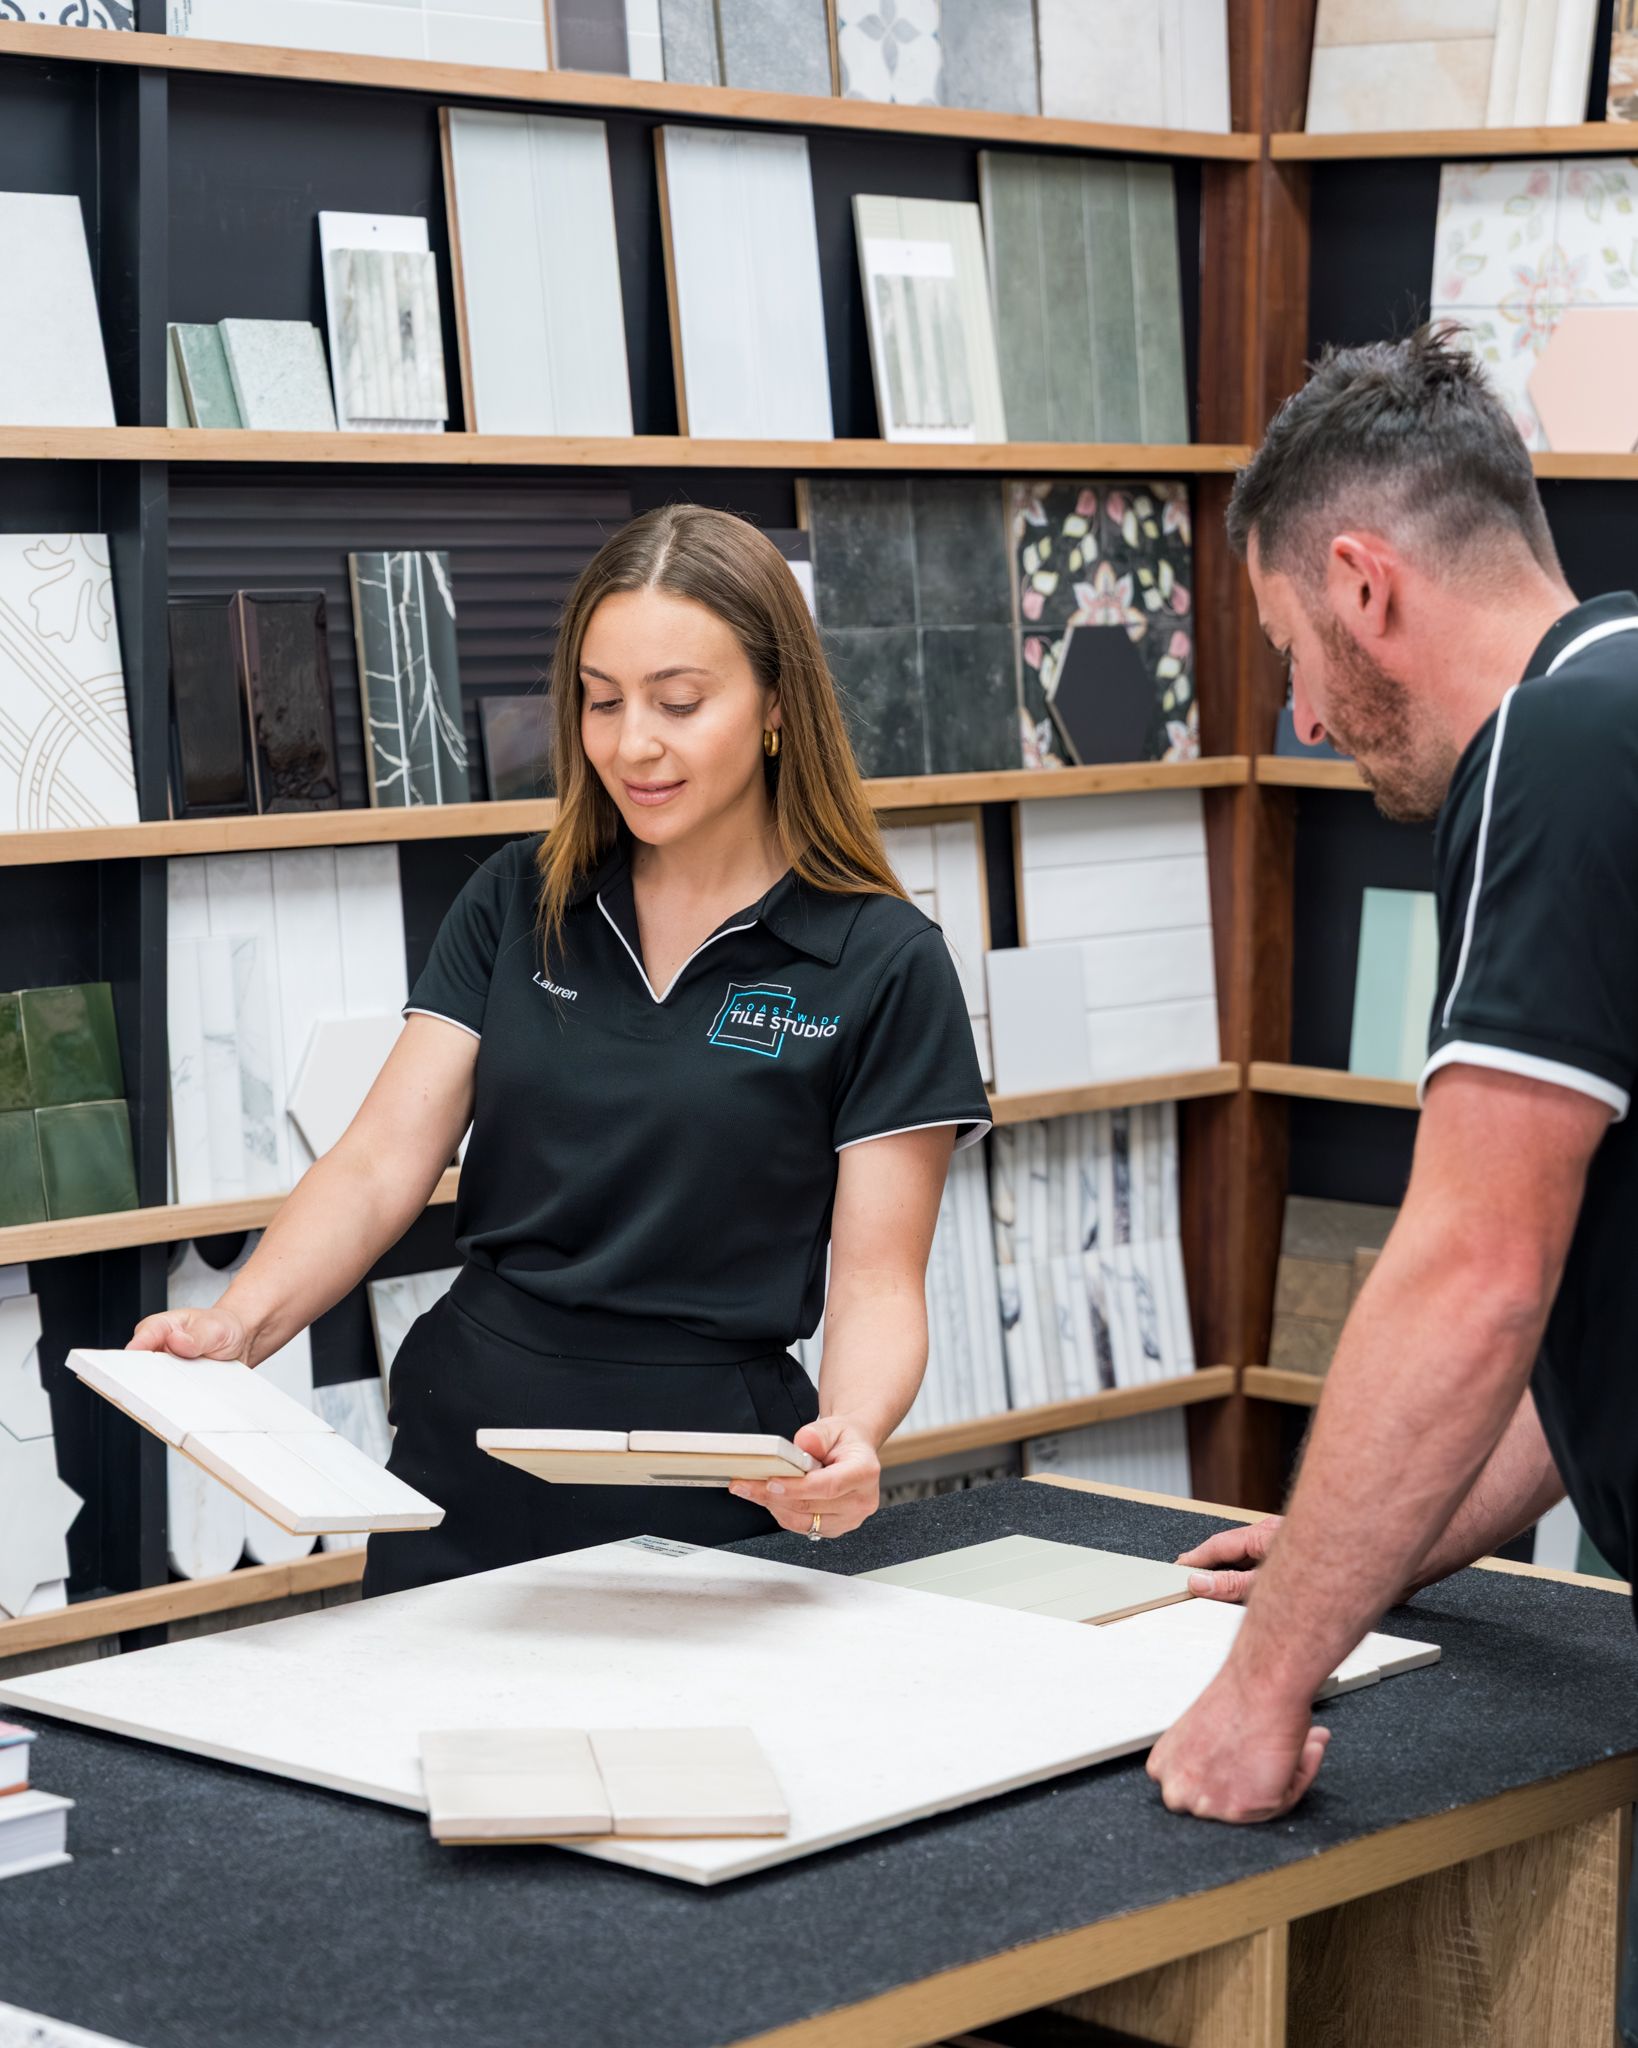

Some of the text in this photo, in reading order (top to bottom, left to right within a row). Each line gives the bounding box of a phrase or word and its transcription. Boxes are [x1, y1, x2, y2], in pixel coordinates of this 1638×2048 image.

[532, 971, 578, 1001] Lauren
[730, 1010, 837, 1038] TILE STUDIO
[734, 1003, 841, 1025] COASTWIDE
